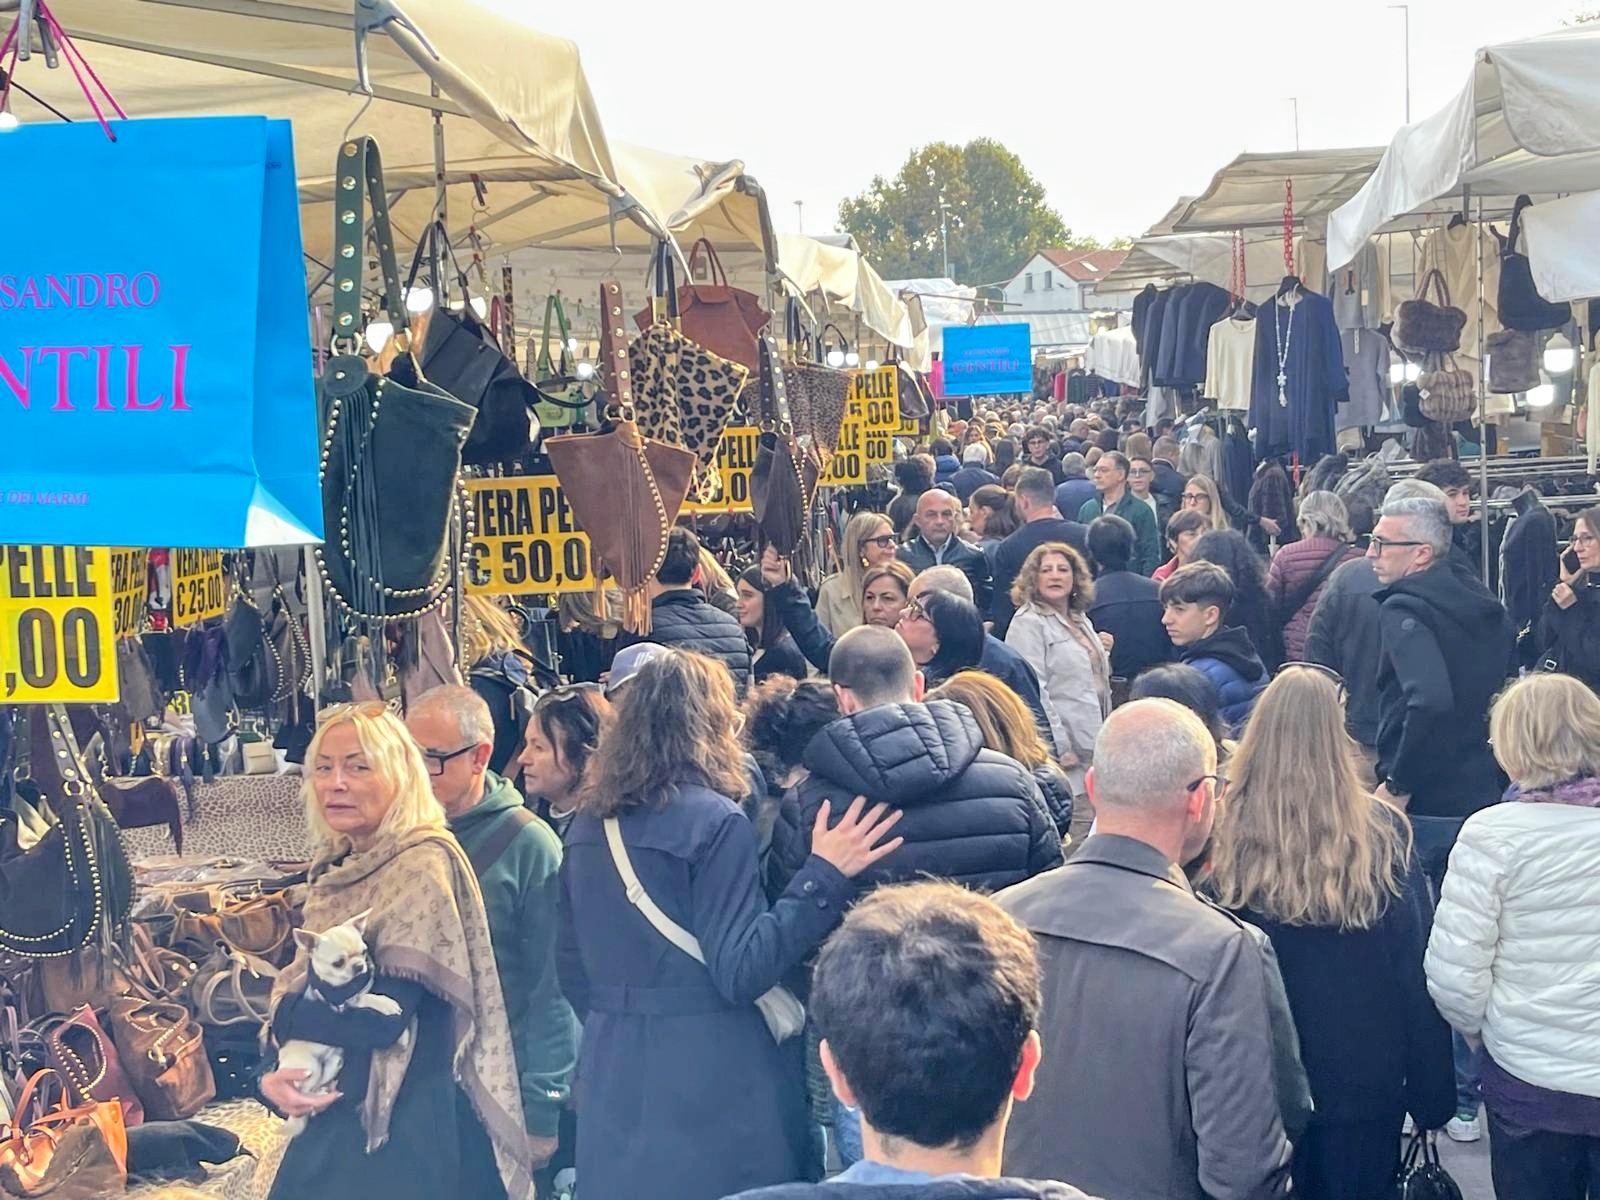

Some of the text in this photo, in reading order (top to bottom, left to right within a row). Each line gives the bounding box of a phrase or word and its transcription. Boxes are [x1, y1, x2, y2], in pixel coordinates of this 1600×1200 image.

[855, 372, 894, 400] PELLE
[717, 435, 759, 468] PELL
[539, 487, 584, 533] PE
[0, 545, 97, 598] ELLE
[502, 538, 588, 587] 50,0
[177, 573, 221, 618] € 25,00
